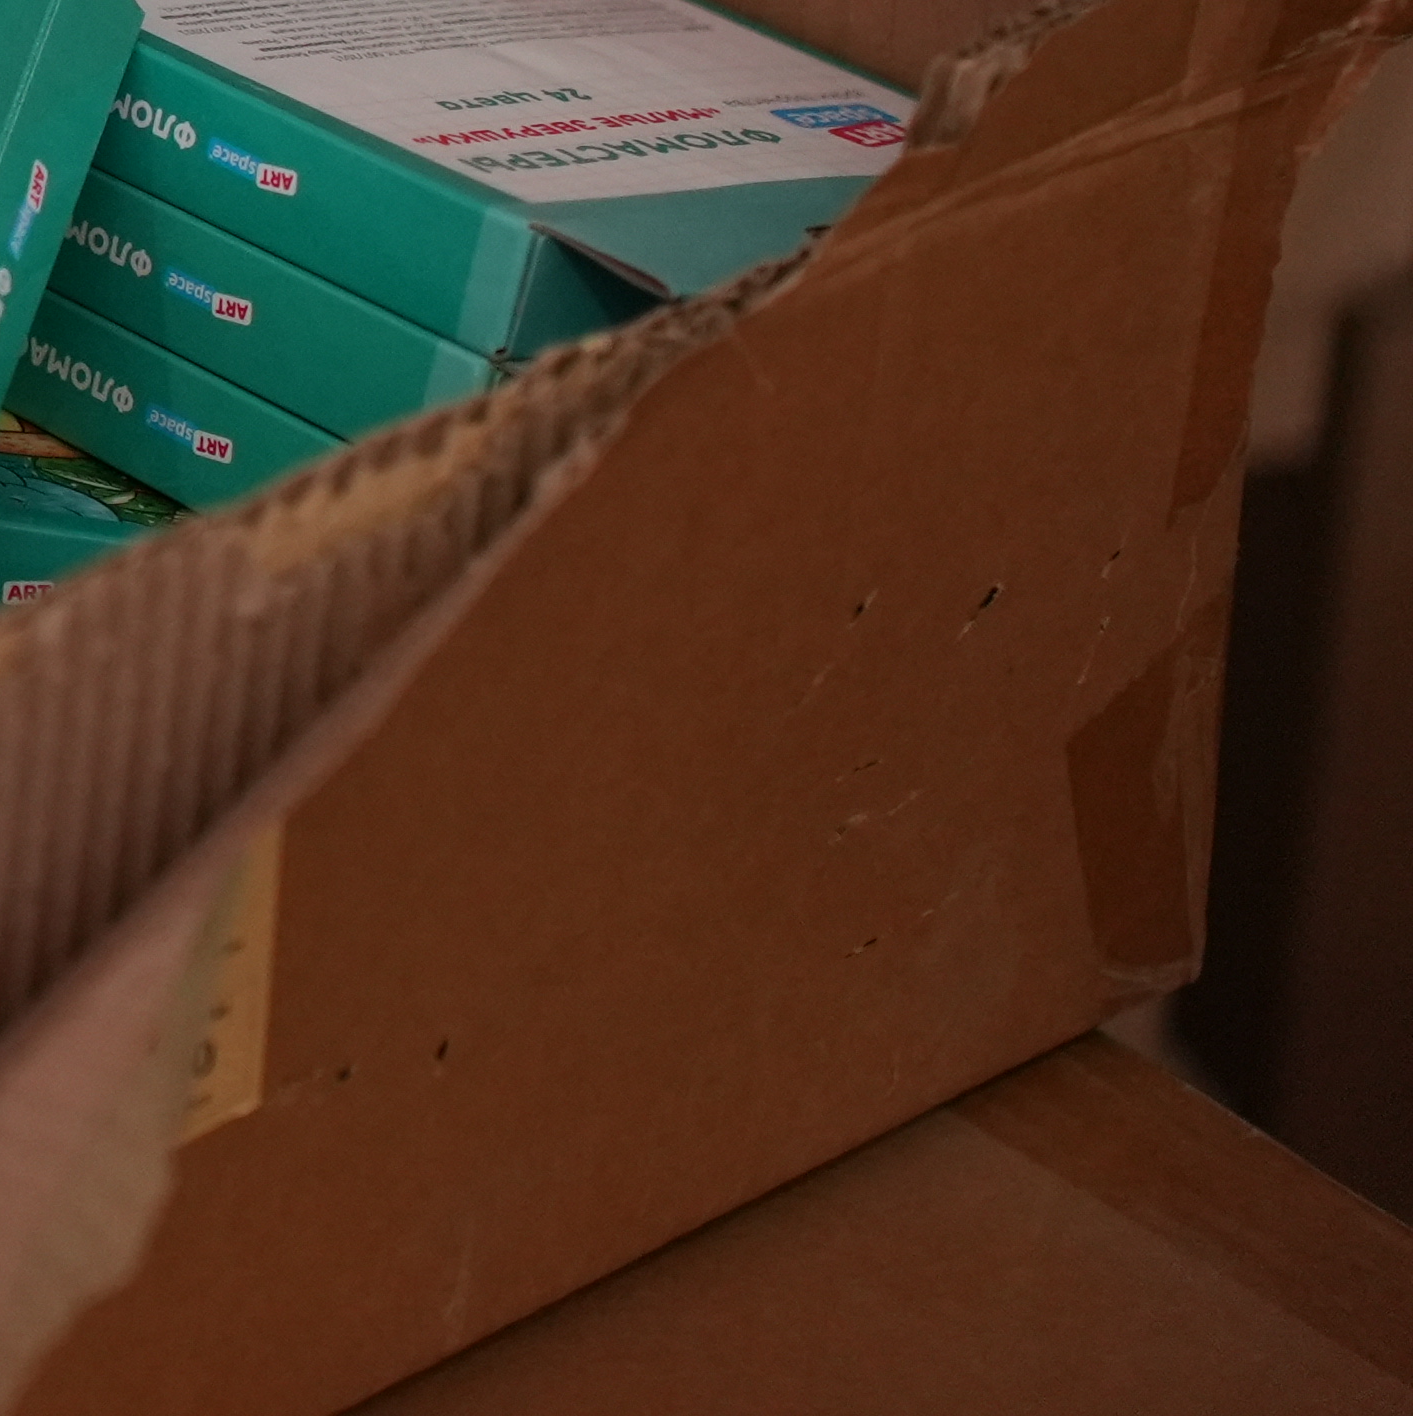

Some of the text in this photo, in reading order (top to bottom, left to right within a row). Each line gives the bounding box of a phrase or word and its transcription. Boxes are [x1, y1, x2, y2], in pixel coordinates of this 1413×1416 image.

[436, 86, 593, 112] 24 цвета
[412, 105, 722, 148] «МИЛЫЕ ЗВЕРУШКИ»
[457, 126, 782, 176] ФЛОМАСТЕРЫ
[258, 166, 296, 192] ART
[214, 297, 250, 322] ART
[195, 434, 230, 460] ART
